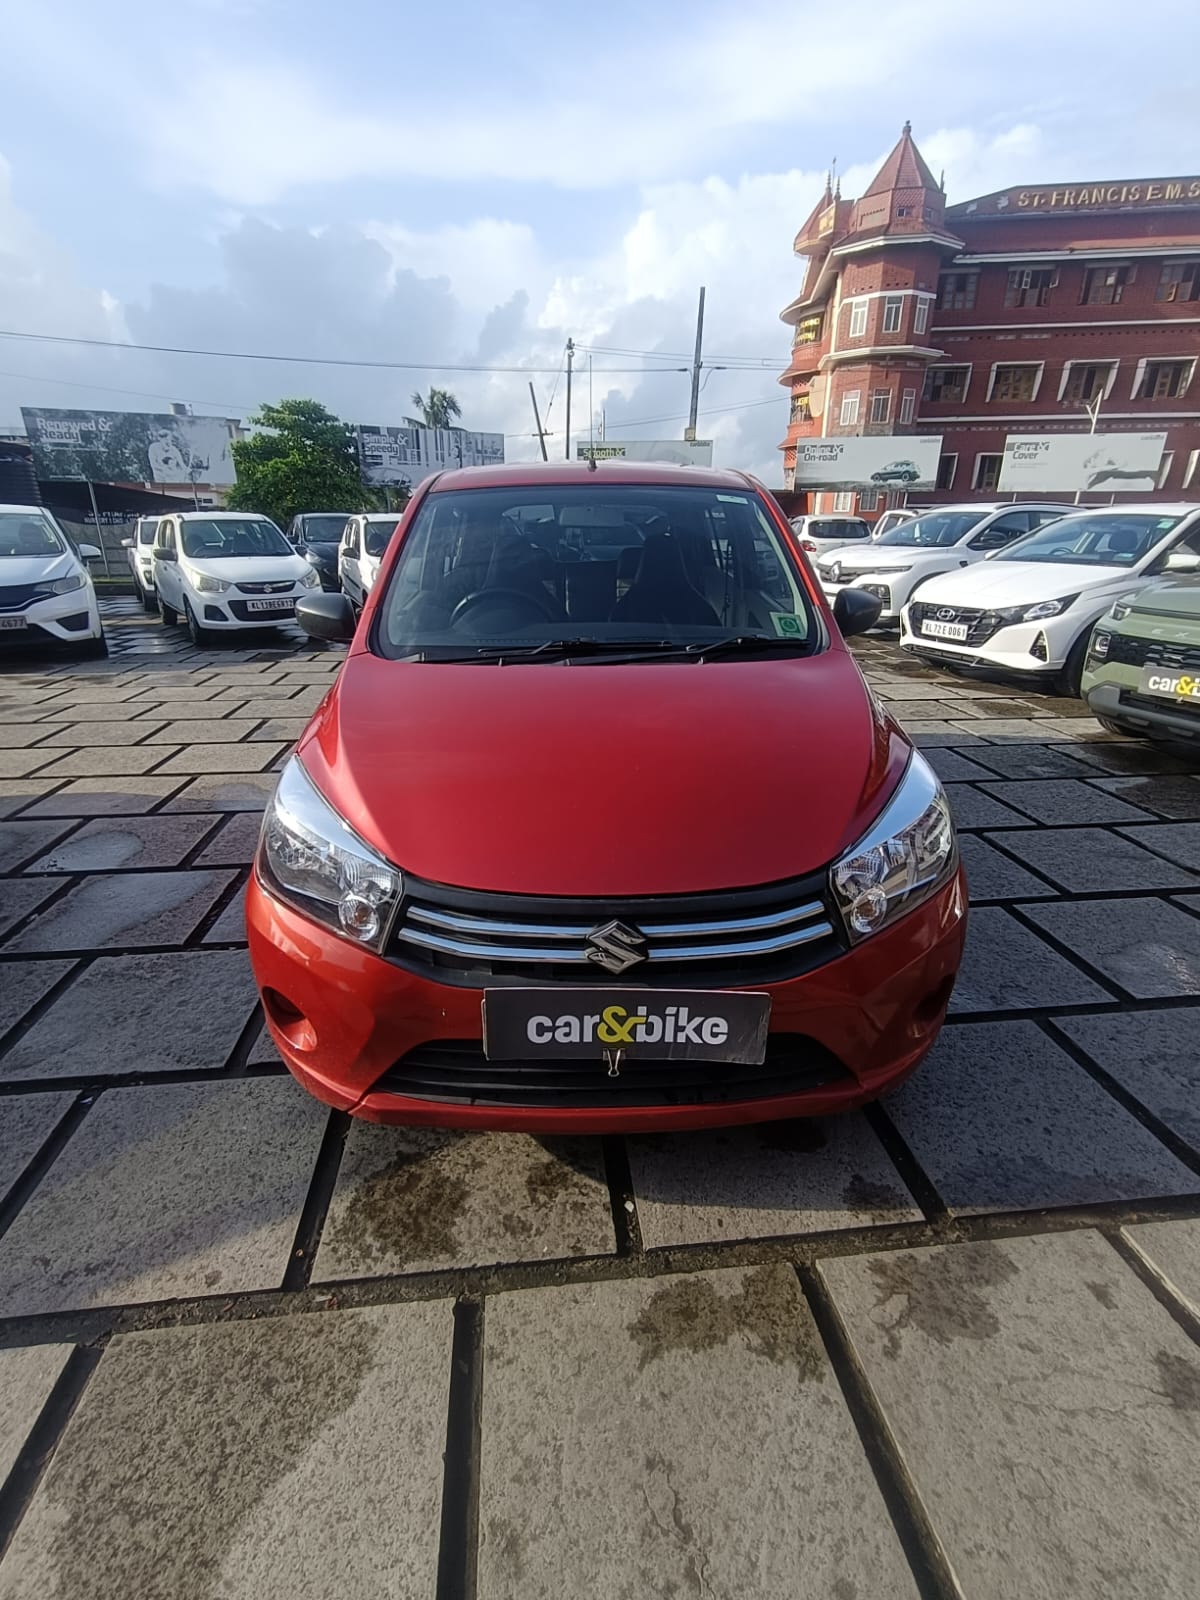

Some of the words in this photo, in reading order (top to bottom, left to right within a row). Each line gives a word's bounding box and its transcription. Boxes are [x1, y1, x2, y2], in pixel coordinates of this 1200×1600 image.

[1018, 191, 1045, 208] ST.
[1050, 185, 1140, 206] FRANCIS
[36, 418, 96, 431] Renewed
[98, 417, 113, 432] &
[41, 430, 80, 443] Ready
[363, 433, 395, 445] Simple
[397, 433, 408, 446] &
[365, 445, 399, 456] Speedy
[804, 445, 834, 454] Online
[1013, 451, 1039, 460] Cover
[804, 453, 838, 461] On-road
[526, 1004, 729, 1044] car&bike
